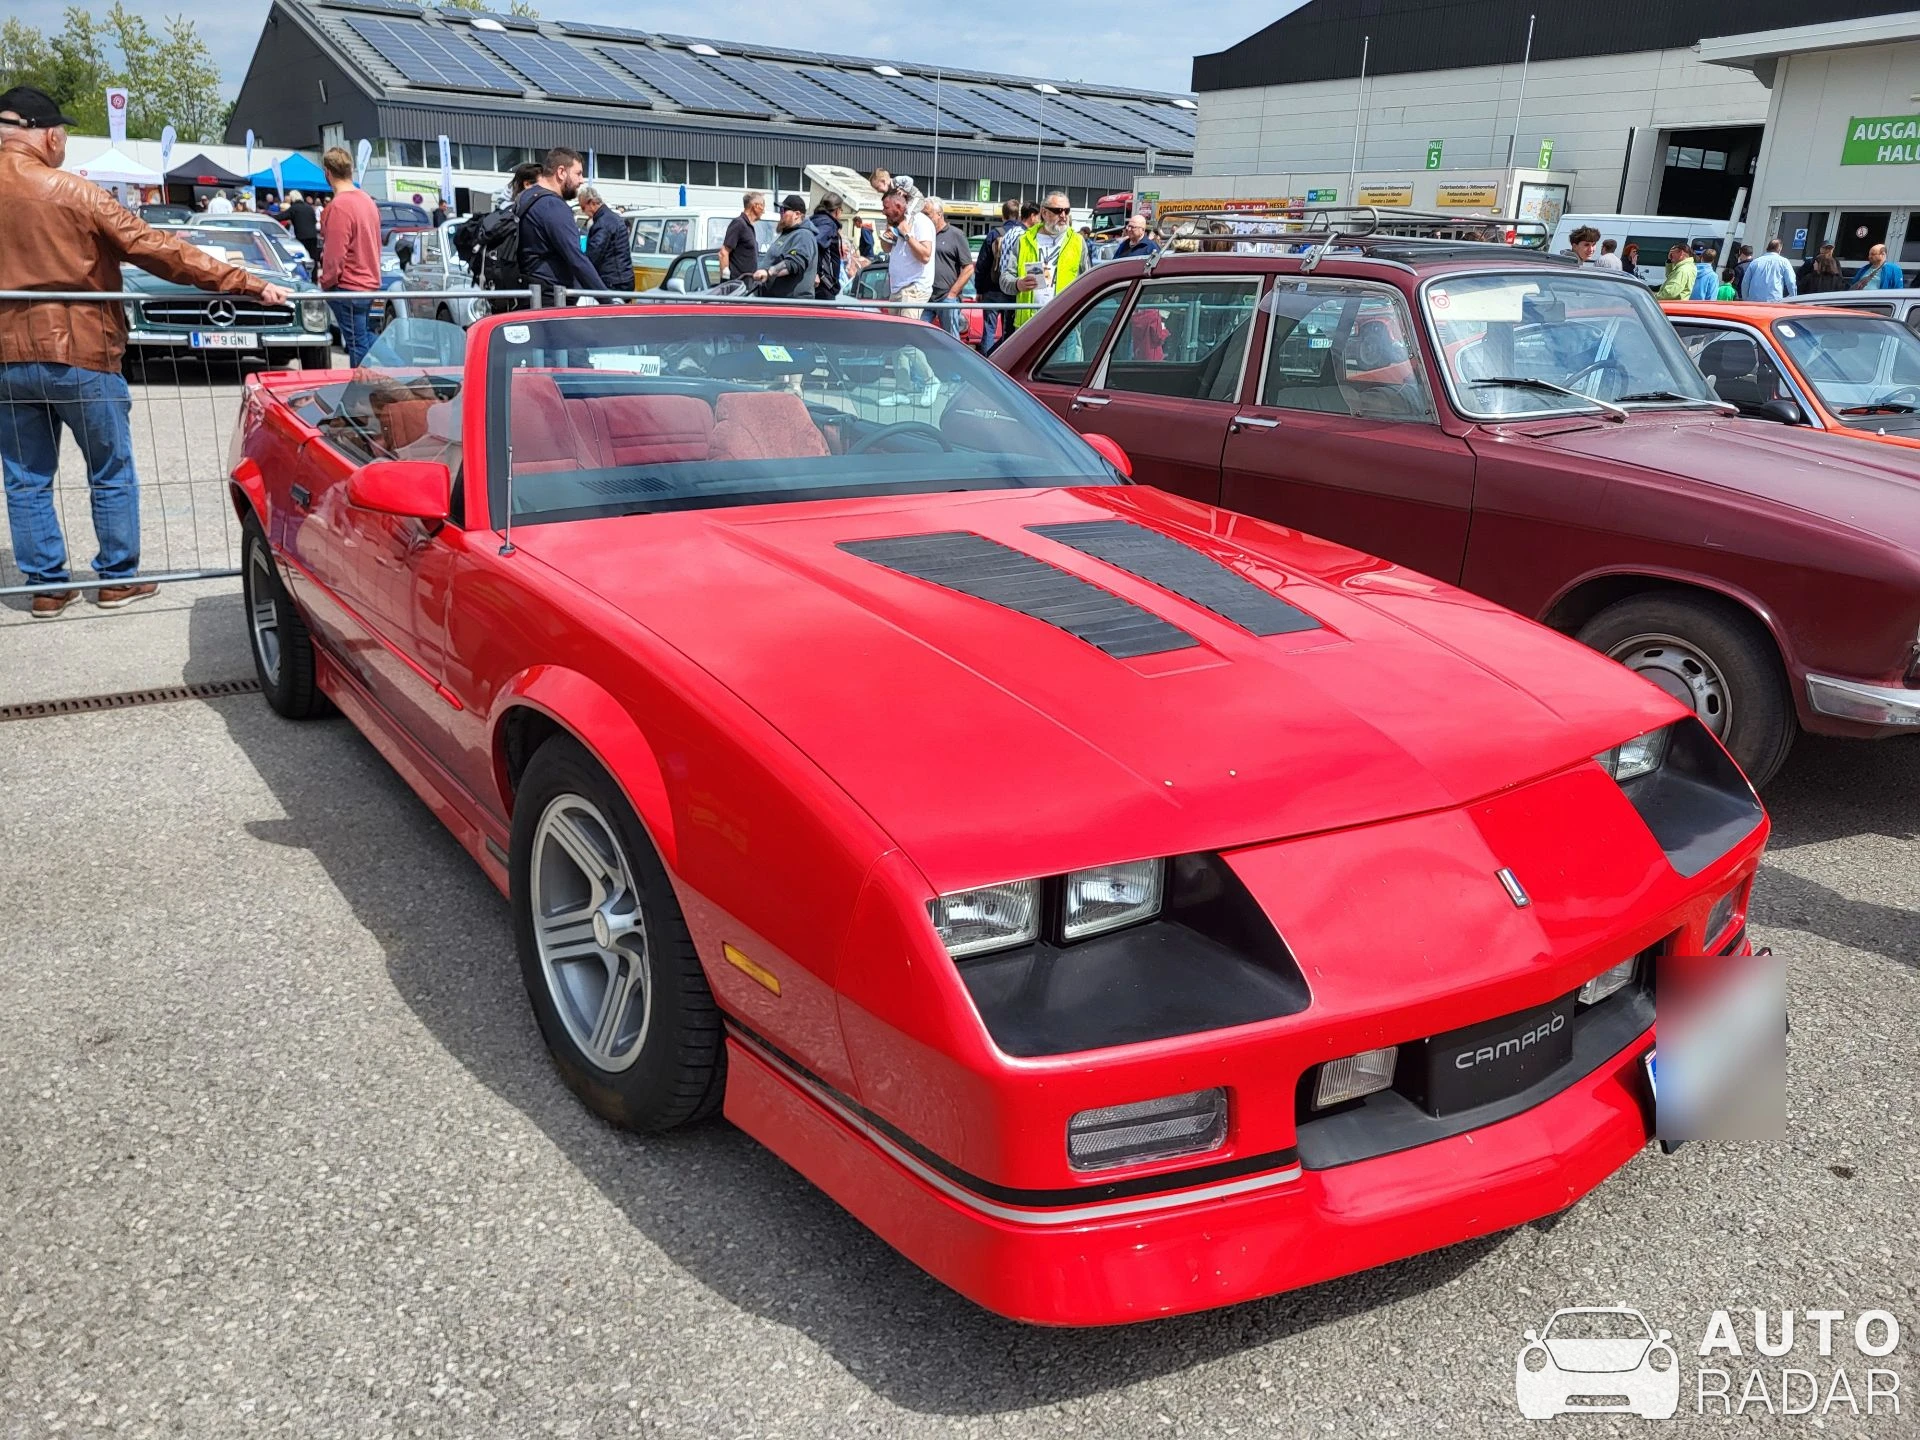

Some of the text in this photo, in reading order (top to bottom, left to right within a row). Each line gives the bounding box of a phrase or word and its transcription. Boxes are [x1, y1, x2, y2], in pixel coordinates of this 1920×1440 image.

[1853, 121, 1920, 141] AUSGA
[1429, 151, 1439, 168] 5
[1541, 151, 1550, 169] 5
[981, 187, 989, 201] 6
[204, 335, 212, 345] W
[220, 335, 228, 346] 9
[640, 363, 659, 374] ZAUN
[1455, 1014, 1565, 1069] CAMARO
